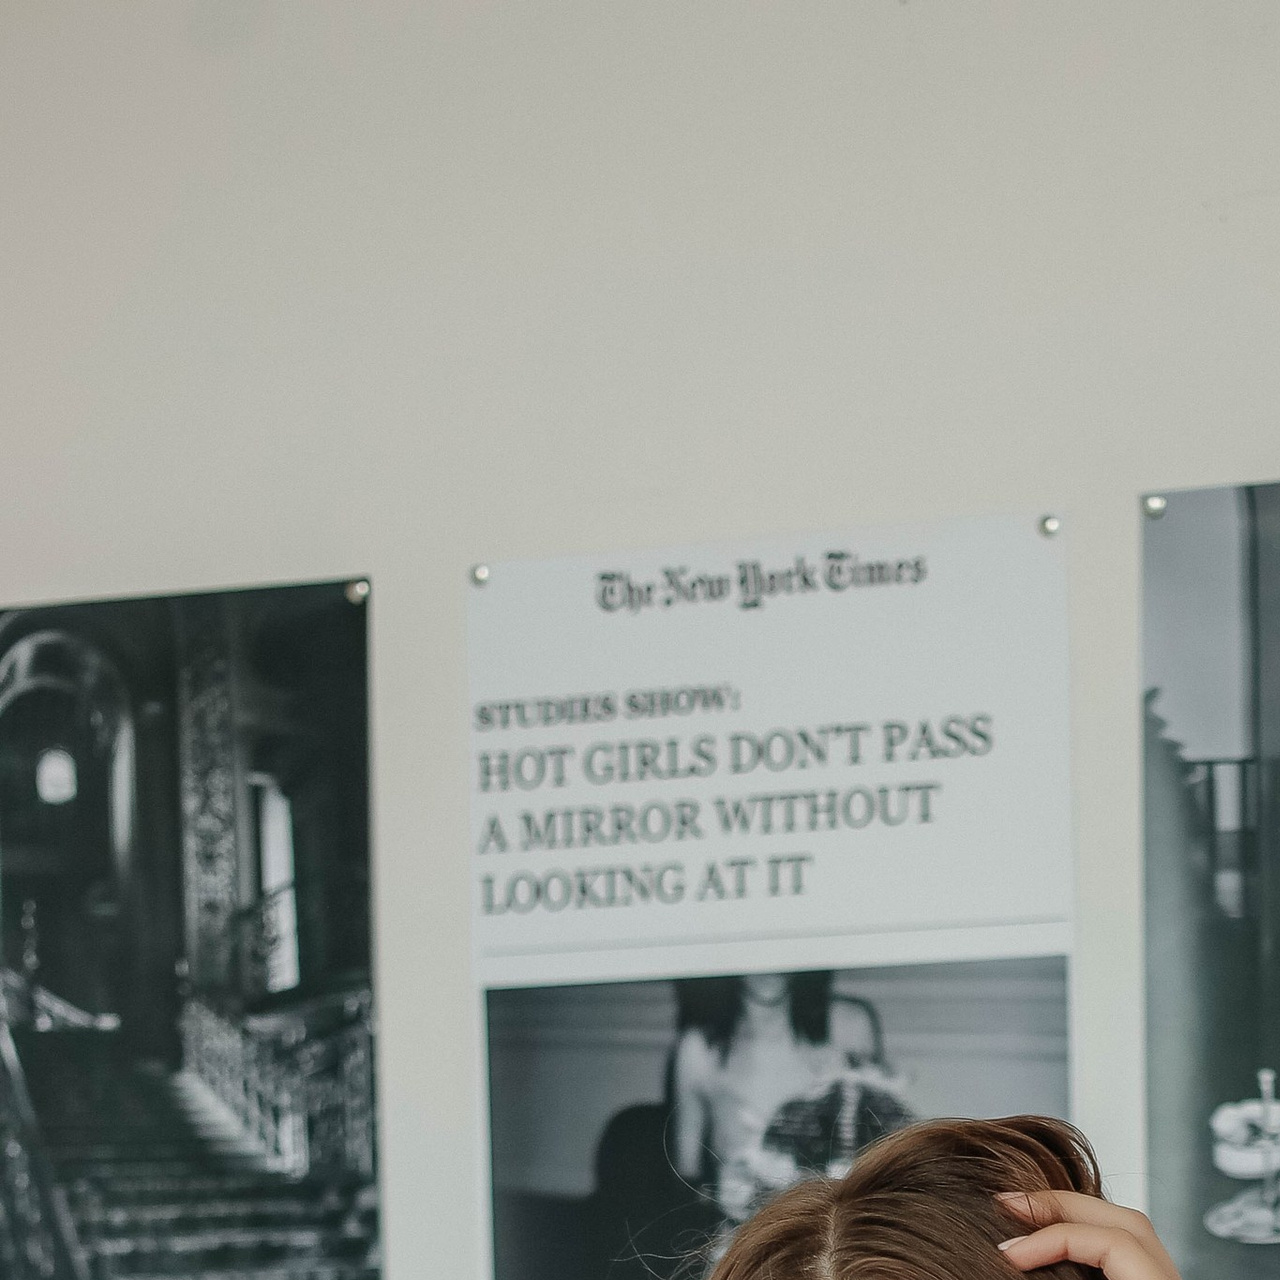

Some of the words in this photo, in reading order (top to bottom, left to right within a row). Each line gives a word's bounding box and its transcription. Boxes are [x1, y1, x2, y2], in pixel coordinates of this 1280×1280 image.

[598, 570, 653, 613] The
[662, 564, 731, 605] New
[737, 556, 820, 611] York
[823, 550, 928, 591] Times
[475, 692, 614, 732] STUDIES
[625, 683, 742, 720] SHOW:
[479, 746, 577, 793] HOT
[583, 734, 719, 786] GIRLS
[729, 724, 870, 775] DON'T
[883, 712, 995, 763] PASS
[479, 815, 509, 855] A
[520, 799, 704, 852] MIRROR
[714, 782, 942, 835] WITHOUT
[481, 861, 686, 916] LOOKING
[699, 856, 757, 901] AT
[767, 854, 813, 897] IT
